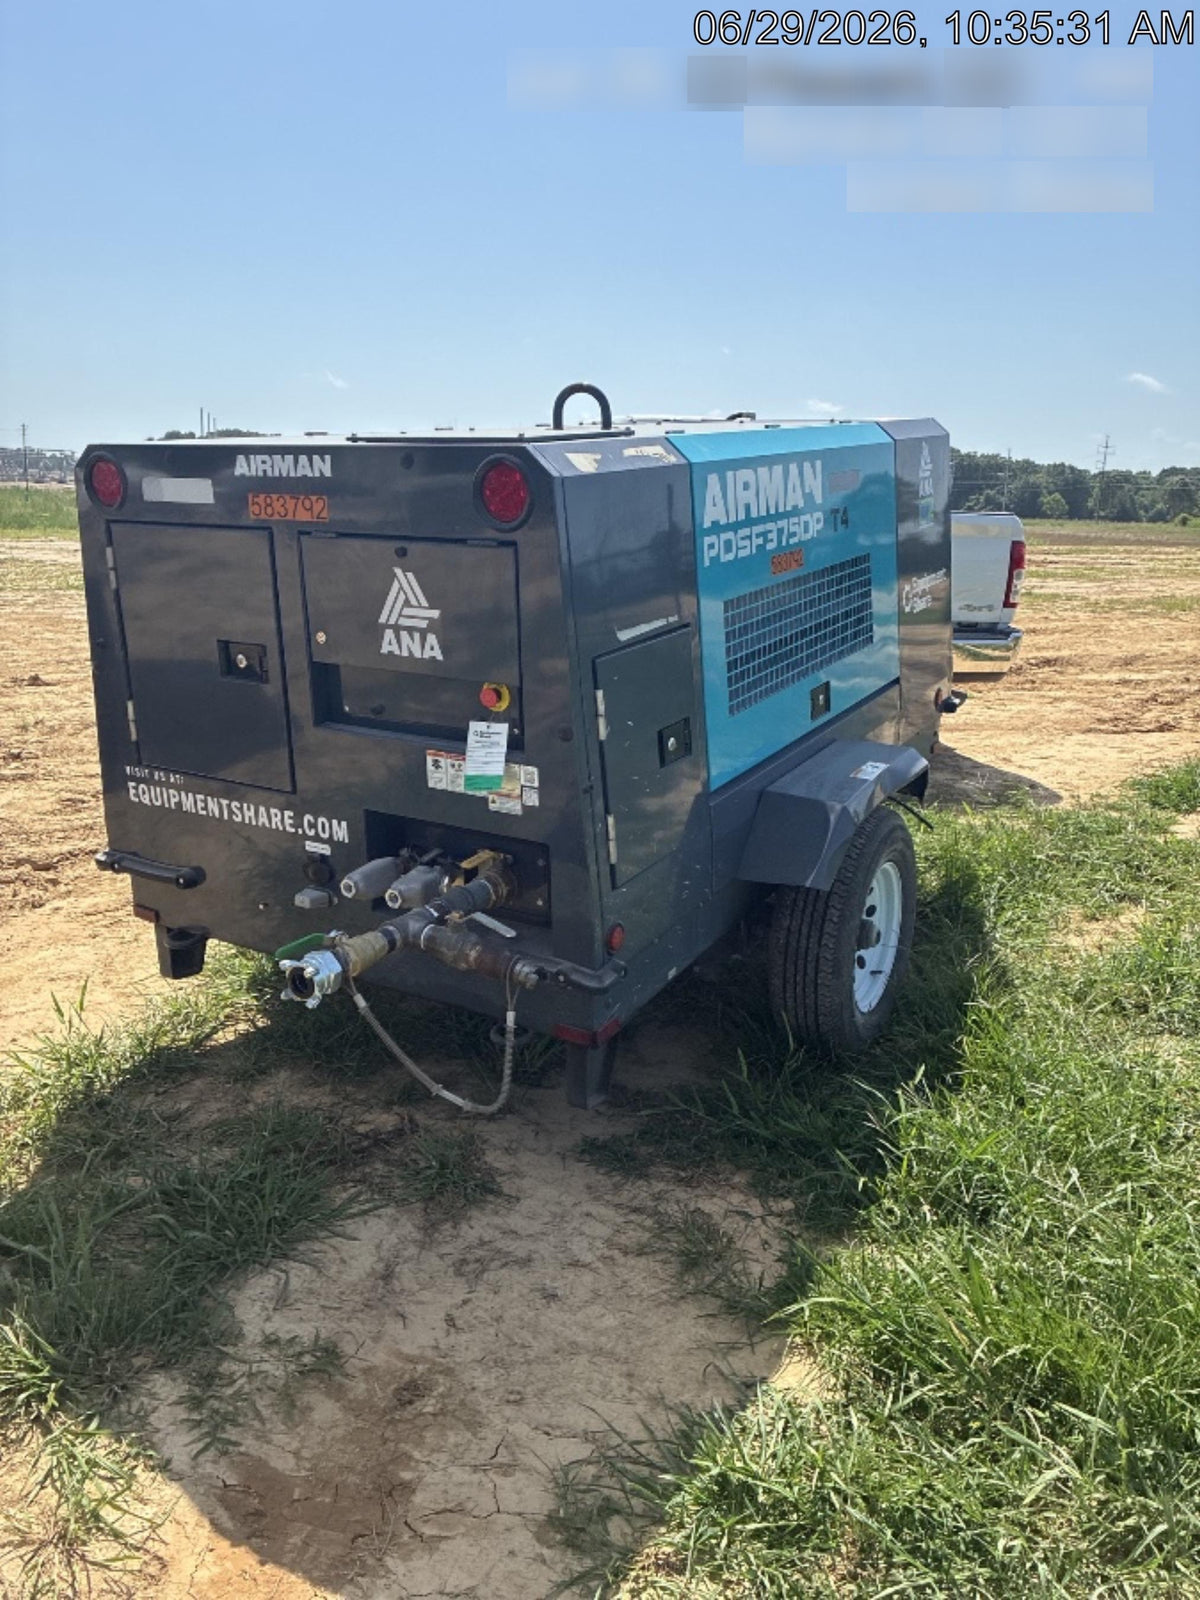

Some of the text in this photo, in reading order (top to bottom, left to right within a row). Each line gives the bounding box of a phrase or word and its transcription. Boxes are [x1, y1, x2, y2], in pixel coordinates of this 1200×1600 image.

[234, 454, 332, 478] AIRMAN
[250, 494, 328, 520] 583792
[703, 460, 823, 528] AIRMAN
[703, 506, 849, 567] PDSF375DP T4
[380, 628, 444, 661] ANA
[125, 765, 149, 779] VISIT
[127, 781, 349, 843] EQUIPMENTSHARE.COM
